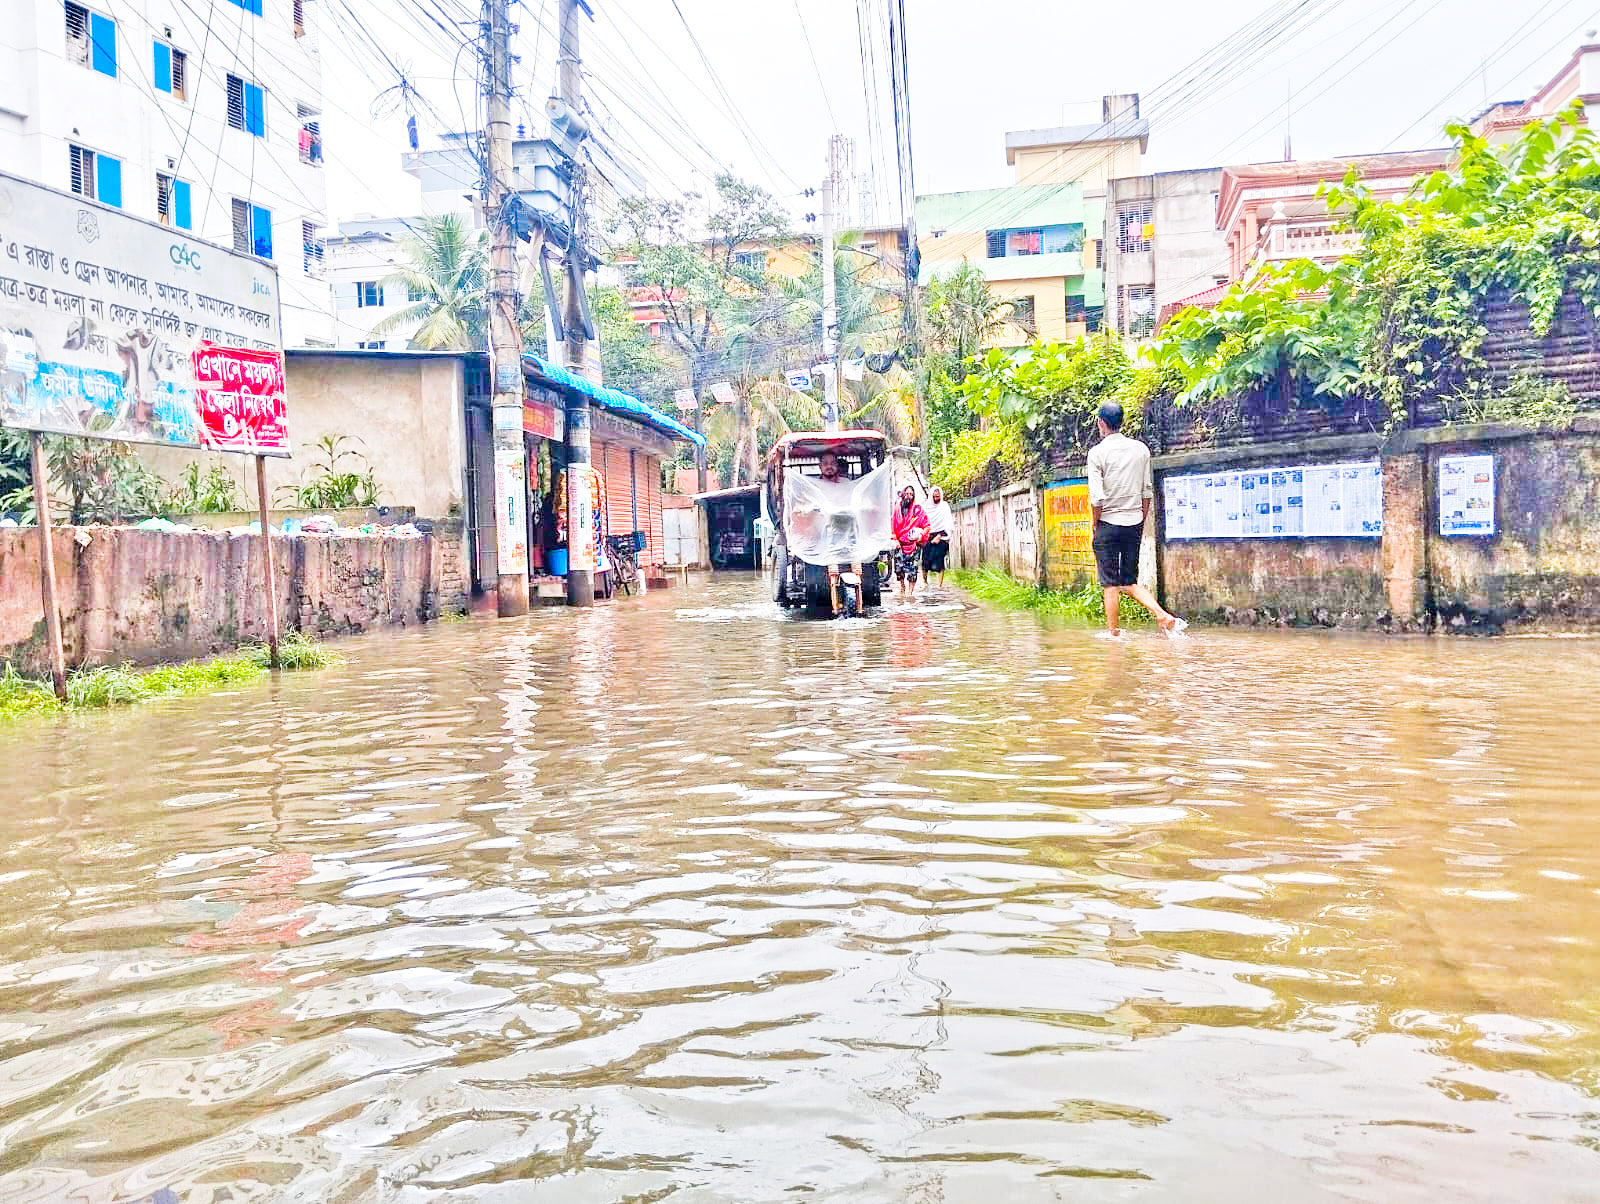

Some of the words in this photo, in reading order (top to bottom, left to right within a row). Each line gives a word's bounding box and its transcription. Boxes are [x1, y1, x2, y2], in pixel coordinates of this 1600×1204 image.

[6, 242, 19, 263] এ
[24, 245, 54, 273] রাস্তা
[59, 257, 70, 275] ও
[75, 260, 100, 285] ড্রেন
[195, 293, 235, 319] আমাদের
[237, 306, 270, 328] সকলের
[52, 288, 85, 316] ময়লা
[89, 298, 104, 320] না
[109, 303, 138, 325] ফেলে
[141, 307, 181, 334] সুনির্দিষ্ট
[200, 354, 242, 383] এখানে
[206, 388, 240, 417] ফেলা
